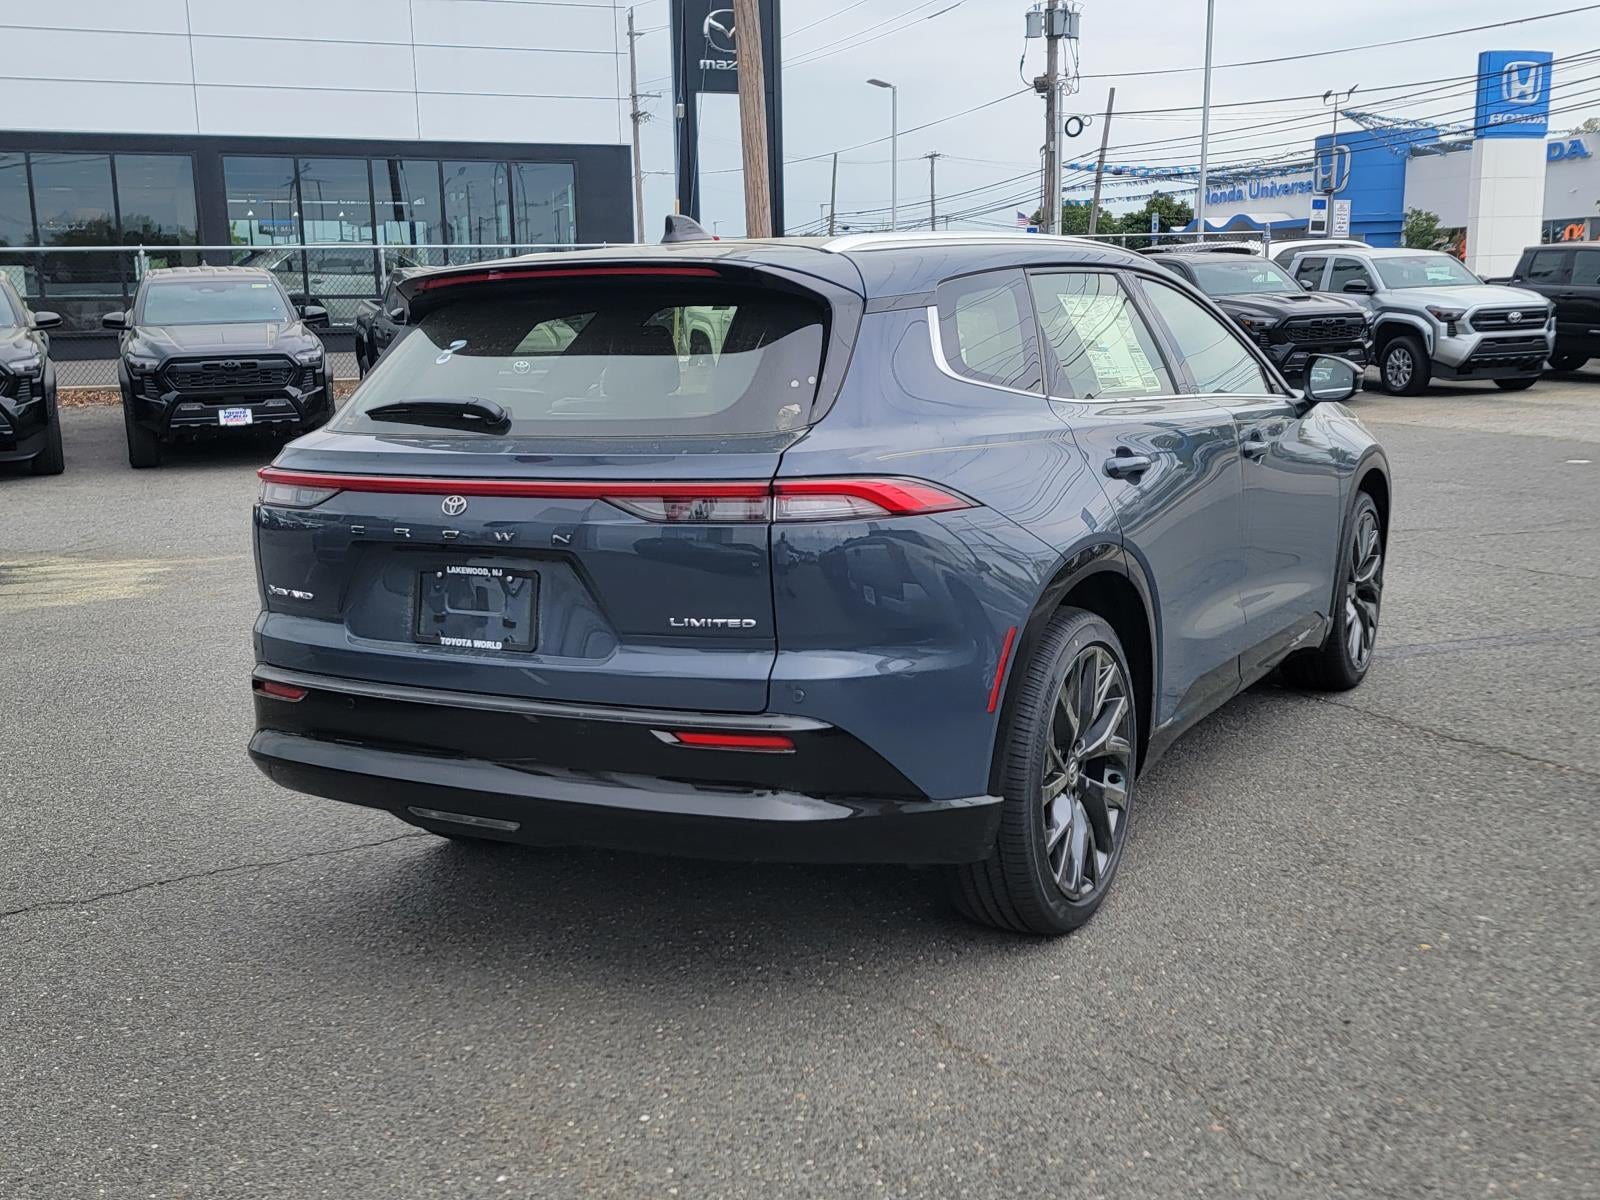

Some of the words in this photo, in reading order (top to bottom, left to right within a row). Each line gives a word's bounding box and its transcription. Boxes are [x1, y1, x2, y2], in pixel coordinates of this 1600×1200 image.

[699, 59, 738, 70] maz
[1488, 113, 1547, 125] HONDA
[1248, 179, 1314, 199] Universe
[350, 525, 572, 544] CROWN
[446, 566, 491, 577] LAKEWOOD,
[492, 569, 503, 577] NJ
[669, 617, 757, 628] LIMITED
[440, 637, 472, 647] TOYOTA
[473, 639, 503, 650] WORLD
